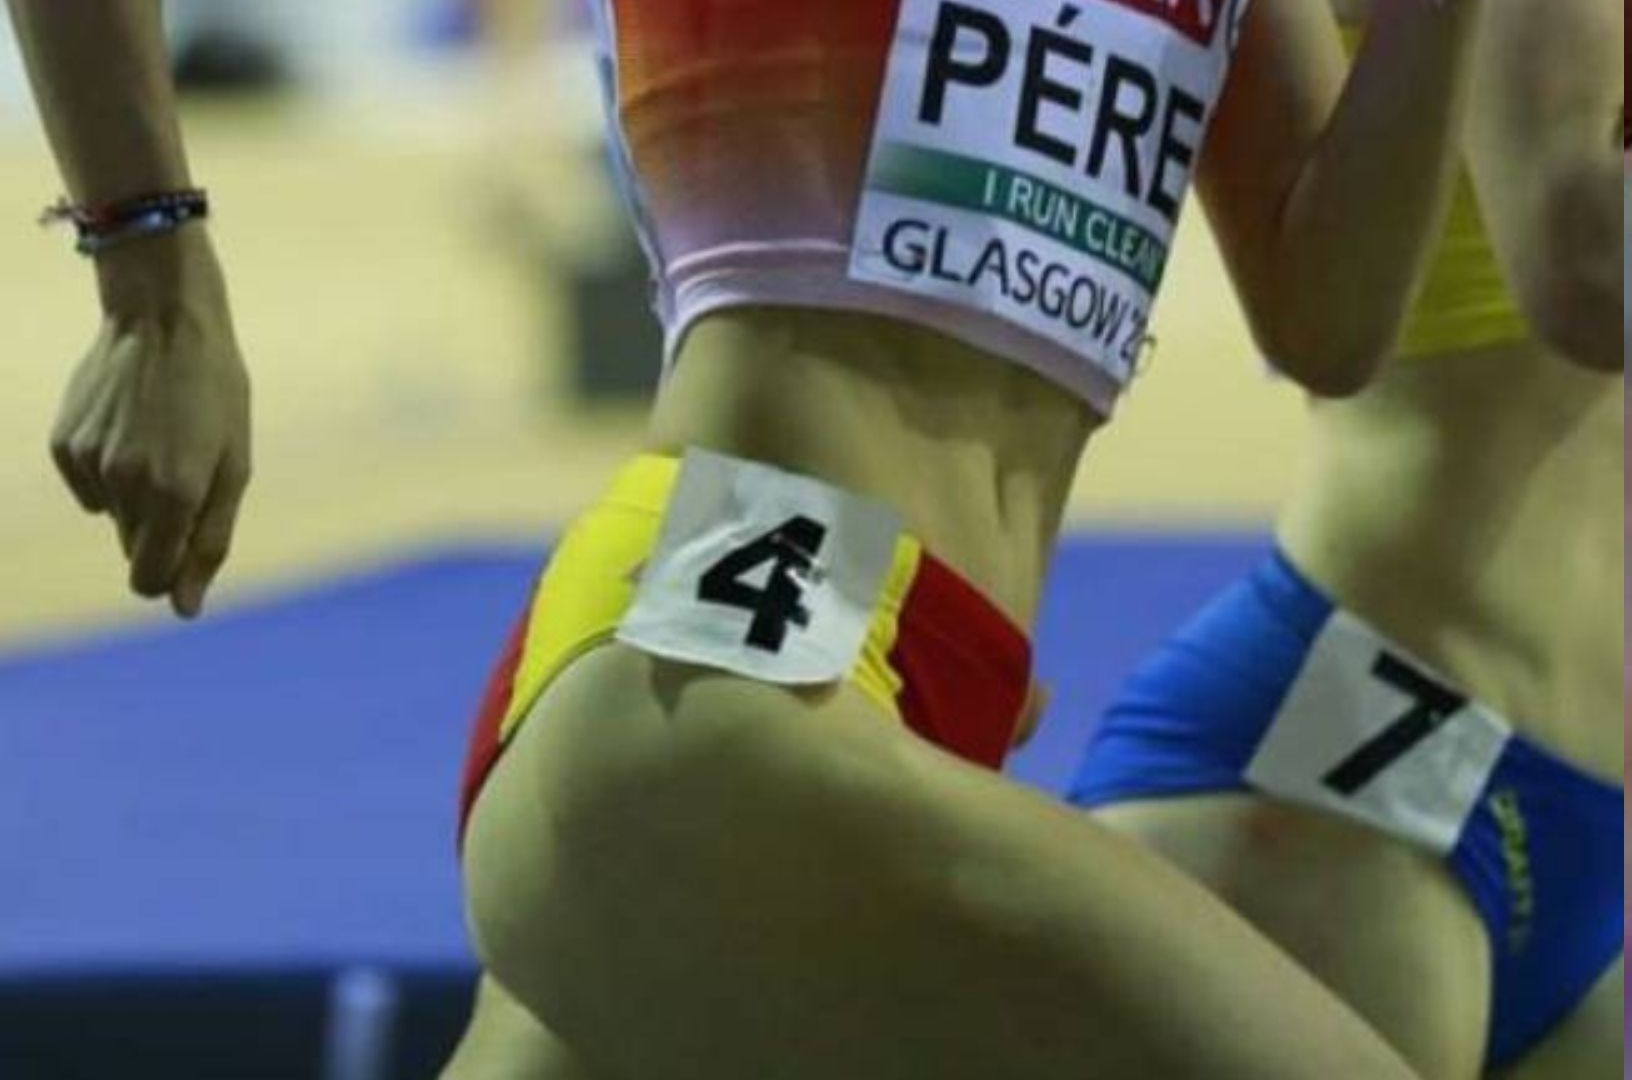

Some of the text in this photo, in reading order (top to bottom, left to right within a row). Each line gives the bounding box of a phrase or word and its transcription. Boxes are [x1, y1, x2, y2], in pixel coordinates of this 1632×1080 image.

[917, 0, 1204, 221] PÉRE
[983, 169, 997, 207] I
[1007, 177, 1079, 239] RUN
[883, 219, 1130, 347] GLASGOW
[698, 514, 827, 654] 4
[1322, 650, 1470, 797] 7
